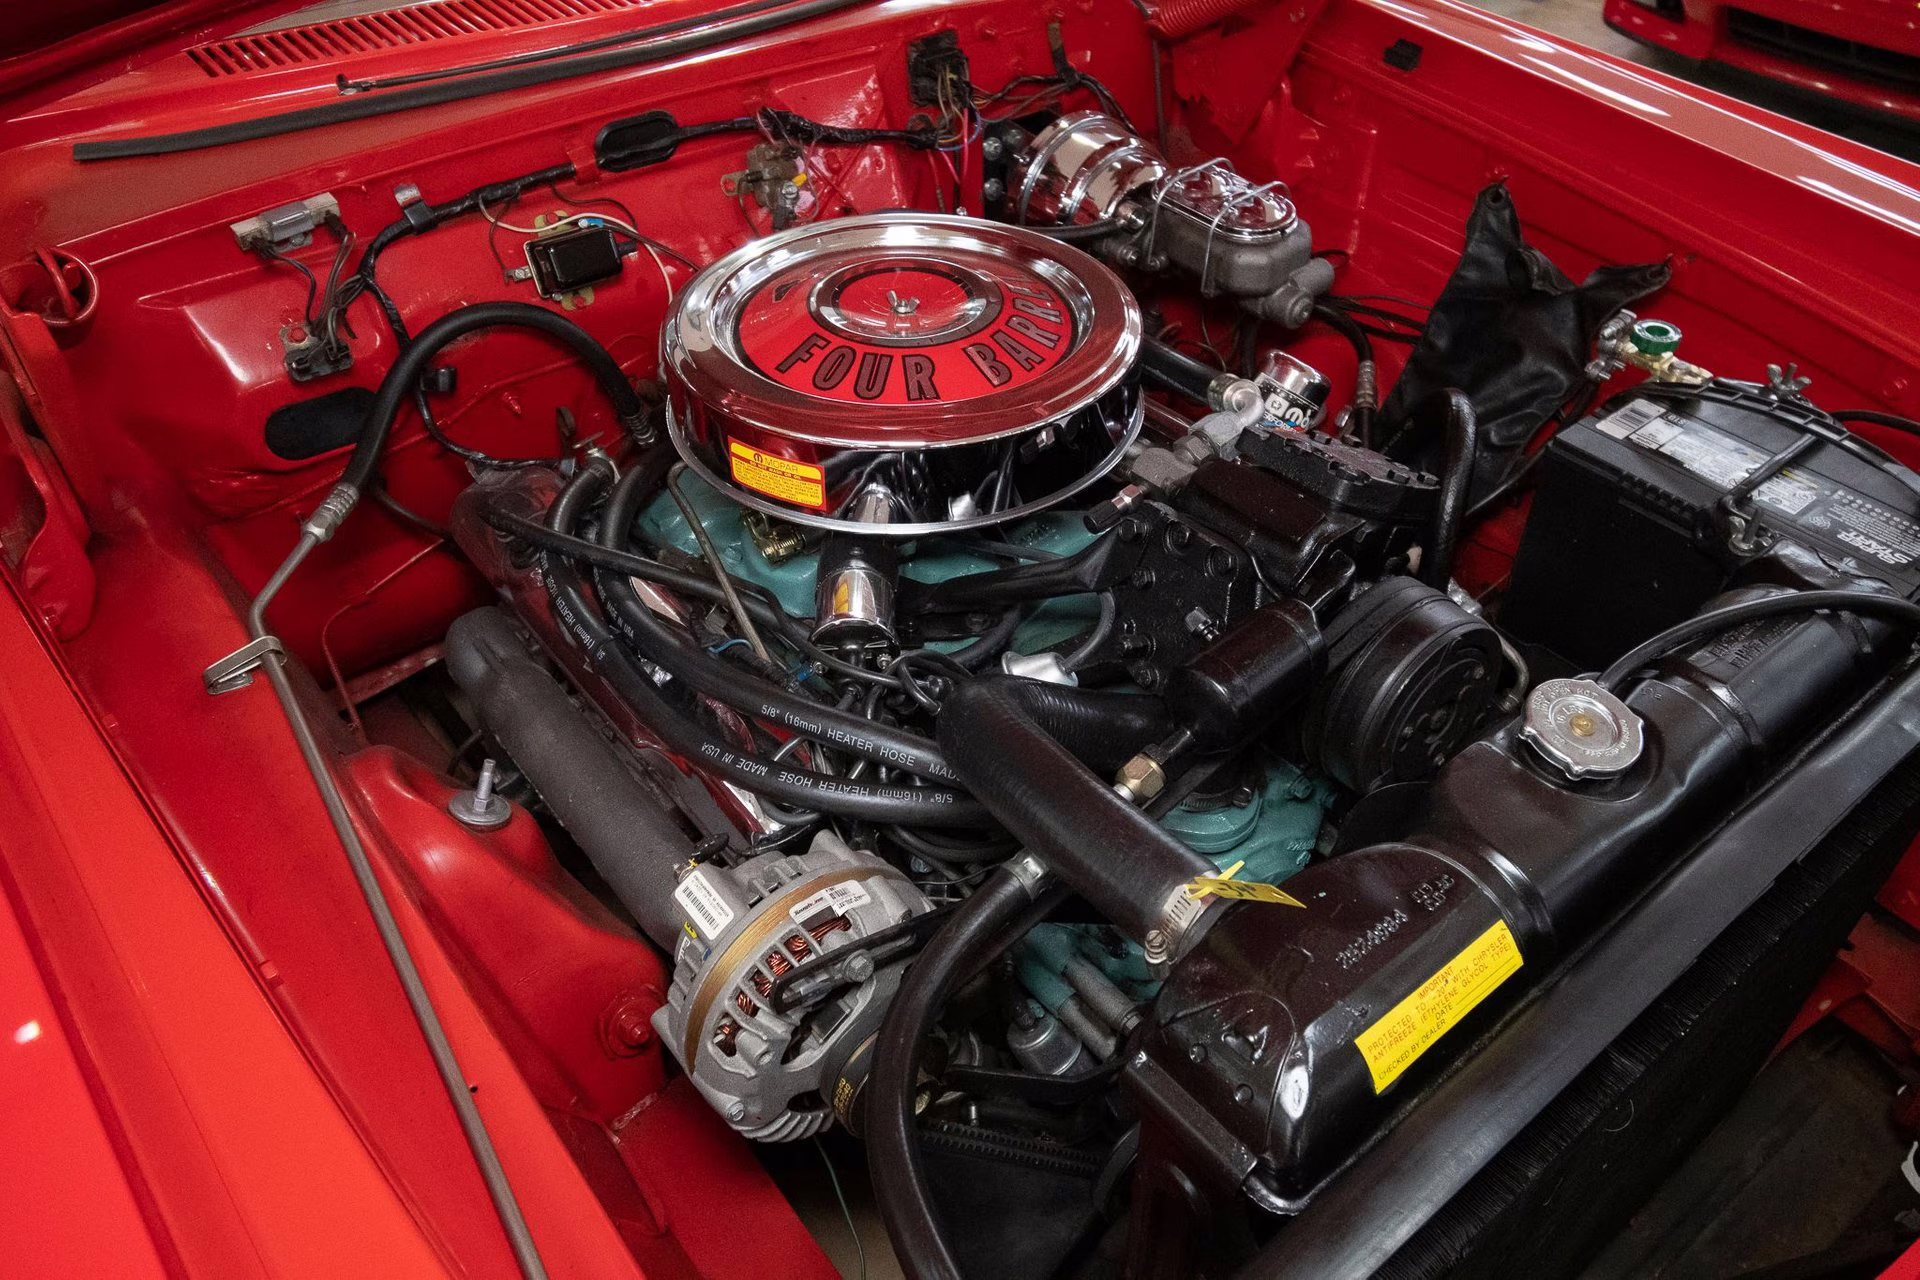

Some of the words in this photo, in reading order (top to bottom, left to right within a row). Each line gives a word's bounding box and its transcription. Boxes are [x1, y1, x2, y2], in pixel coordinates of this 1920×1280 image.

[775, 333, 940, 401] FOUR
[764, 458, 798, 472] MOPAR
[1837, 531, 1896, 564] SUPER
[1848, 530, 1912, 564] START
[556, 597, 576, 626] HEATER
[701, 741, 720, 759] USA
[721, 751, 735, 764] IN
[784, 712, 822, 735] (16mm)
[827, 727, 874, 753] HEATER
[879, 746, 916, 767] HOSE
[928, 763, 961, 782] MAD
[735, 758, 768, 777] MADE
[778, 771, 813, 788] HOSE
[818, 780, 870, 798] HEATER
[877, 788, 923, 802] (16mm)
[1368, 1014, 1412, 1054] PROTECTED
[1415, 1002, 1427, 1014] TO
[1453, 967, 1470, 984] WITH
[1472, 933, 1507, 966] CHRYSLER
[1418, 965, 1455, 999] IMPORTANT
[1373, 1023, 1417, 1062] ANTIFREEZE
[1420, 987, 1459, 1025] (ETHYLENE
[1462, 963, 1488, 988] GLYCOL
[1435, 1002, 1453, 1021] DATE
[1378, 1050, 1410, 1080] CHECKED
[1411, 1041, 1421, 1053] BY
[1421, 1018, 1446, 1043] DEALER
